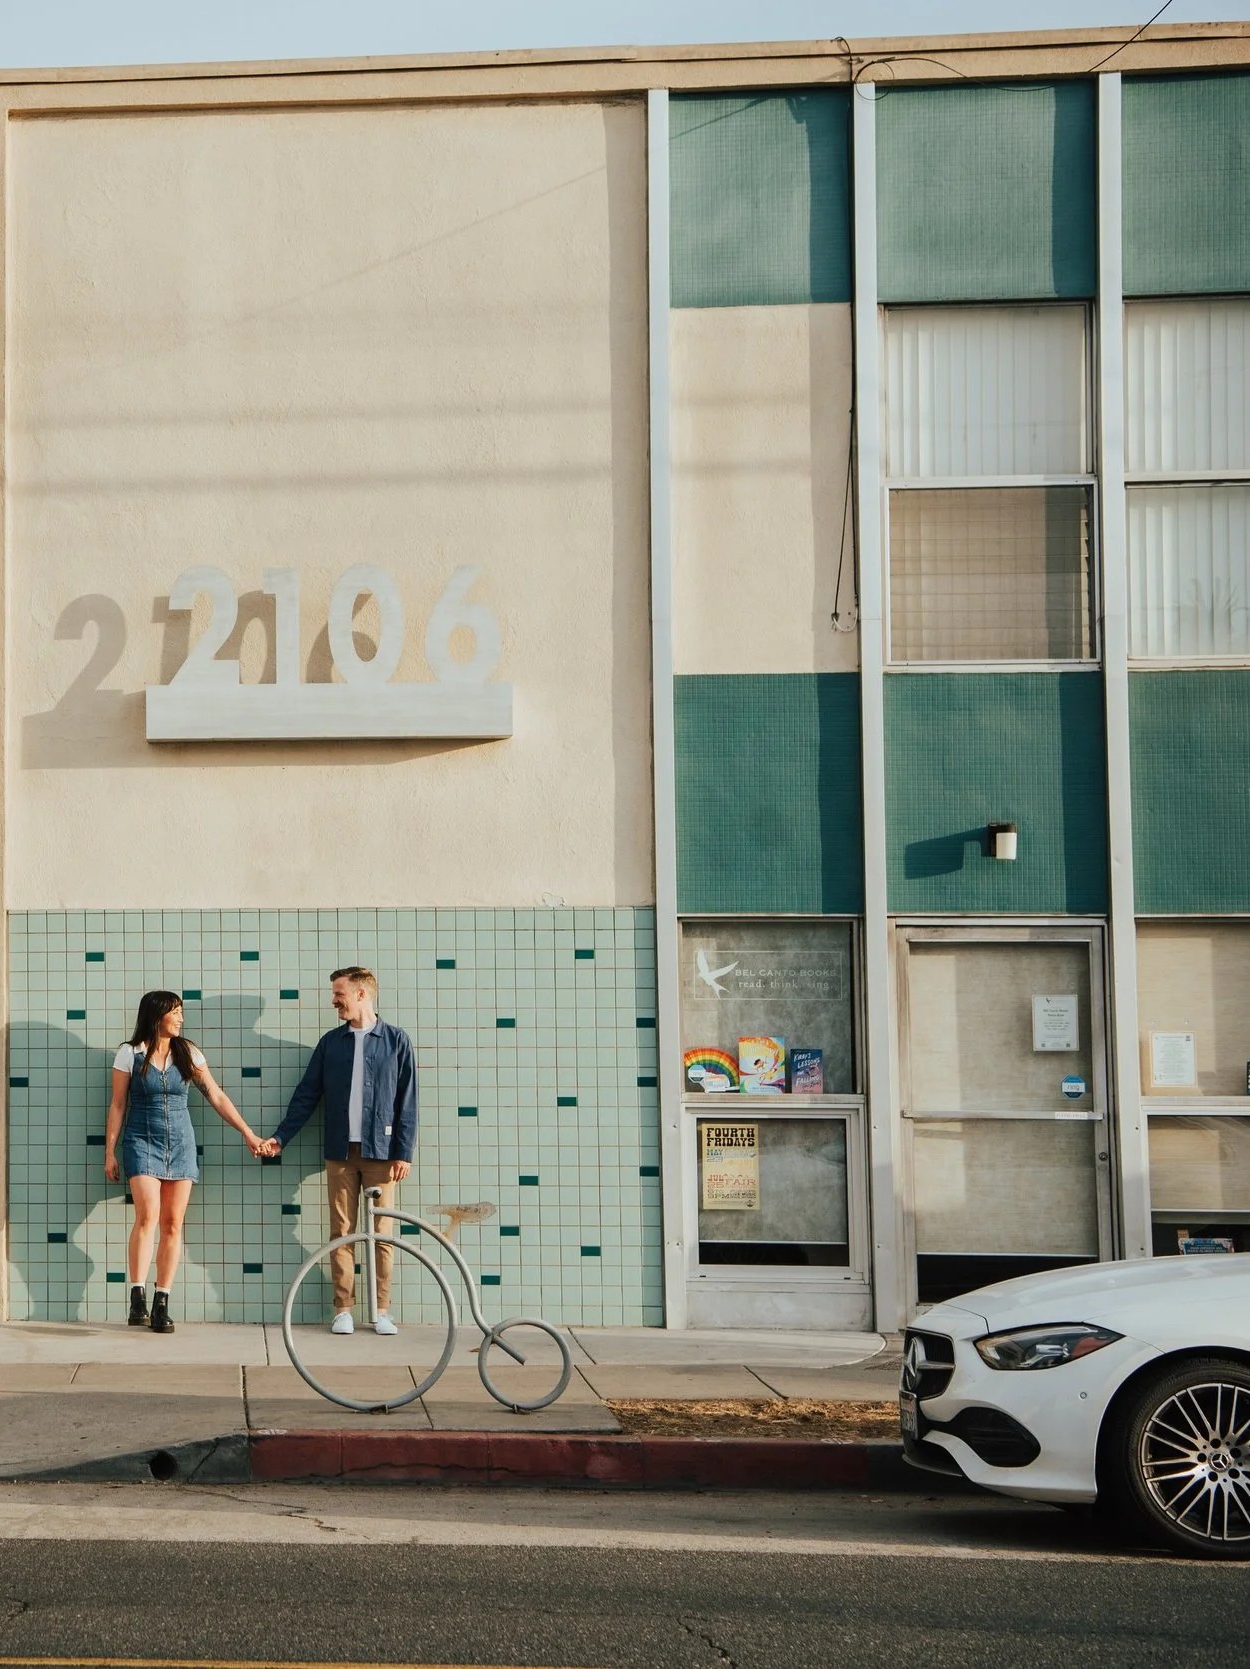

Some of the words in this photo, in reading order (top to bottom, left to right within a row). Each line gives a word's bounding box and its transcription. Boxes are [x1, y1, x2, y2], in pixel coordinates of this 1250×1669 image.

[167, 562, 503, 686] 2106
[735, 969, 756, 977] BEL
[759, 969, 796, 977] CANTO
[800, 969, 837, 977] BOOKS
[738, 979, 766, 989] read.
[706, 1127, 755, 1138] FOURTH
[706, 1137, 755, 1147] FRIDAYS
